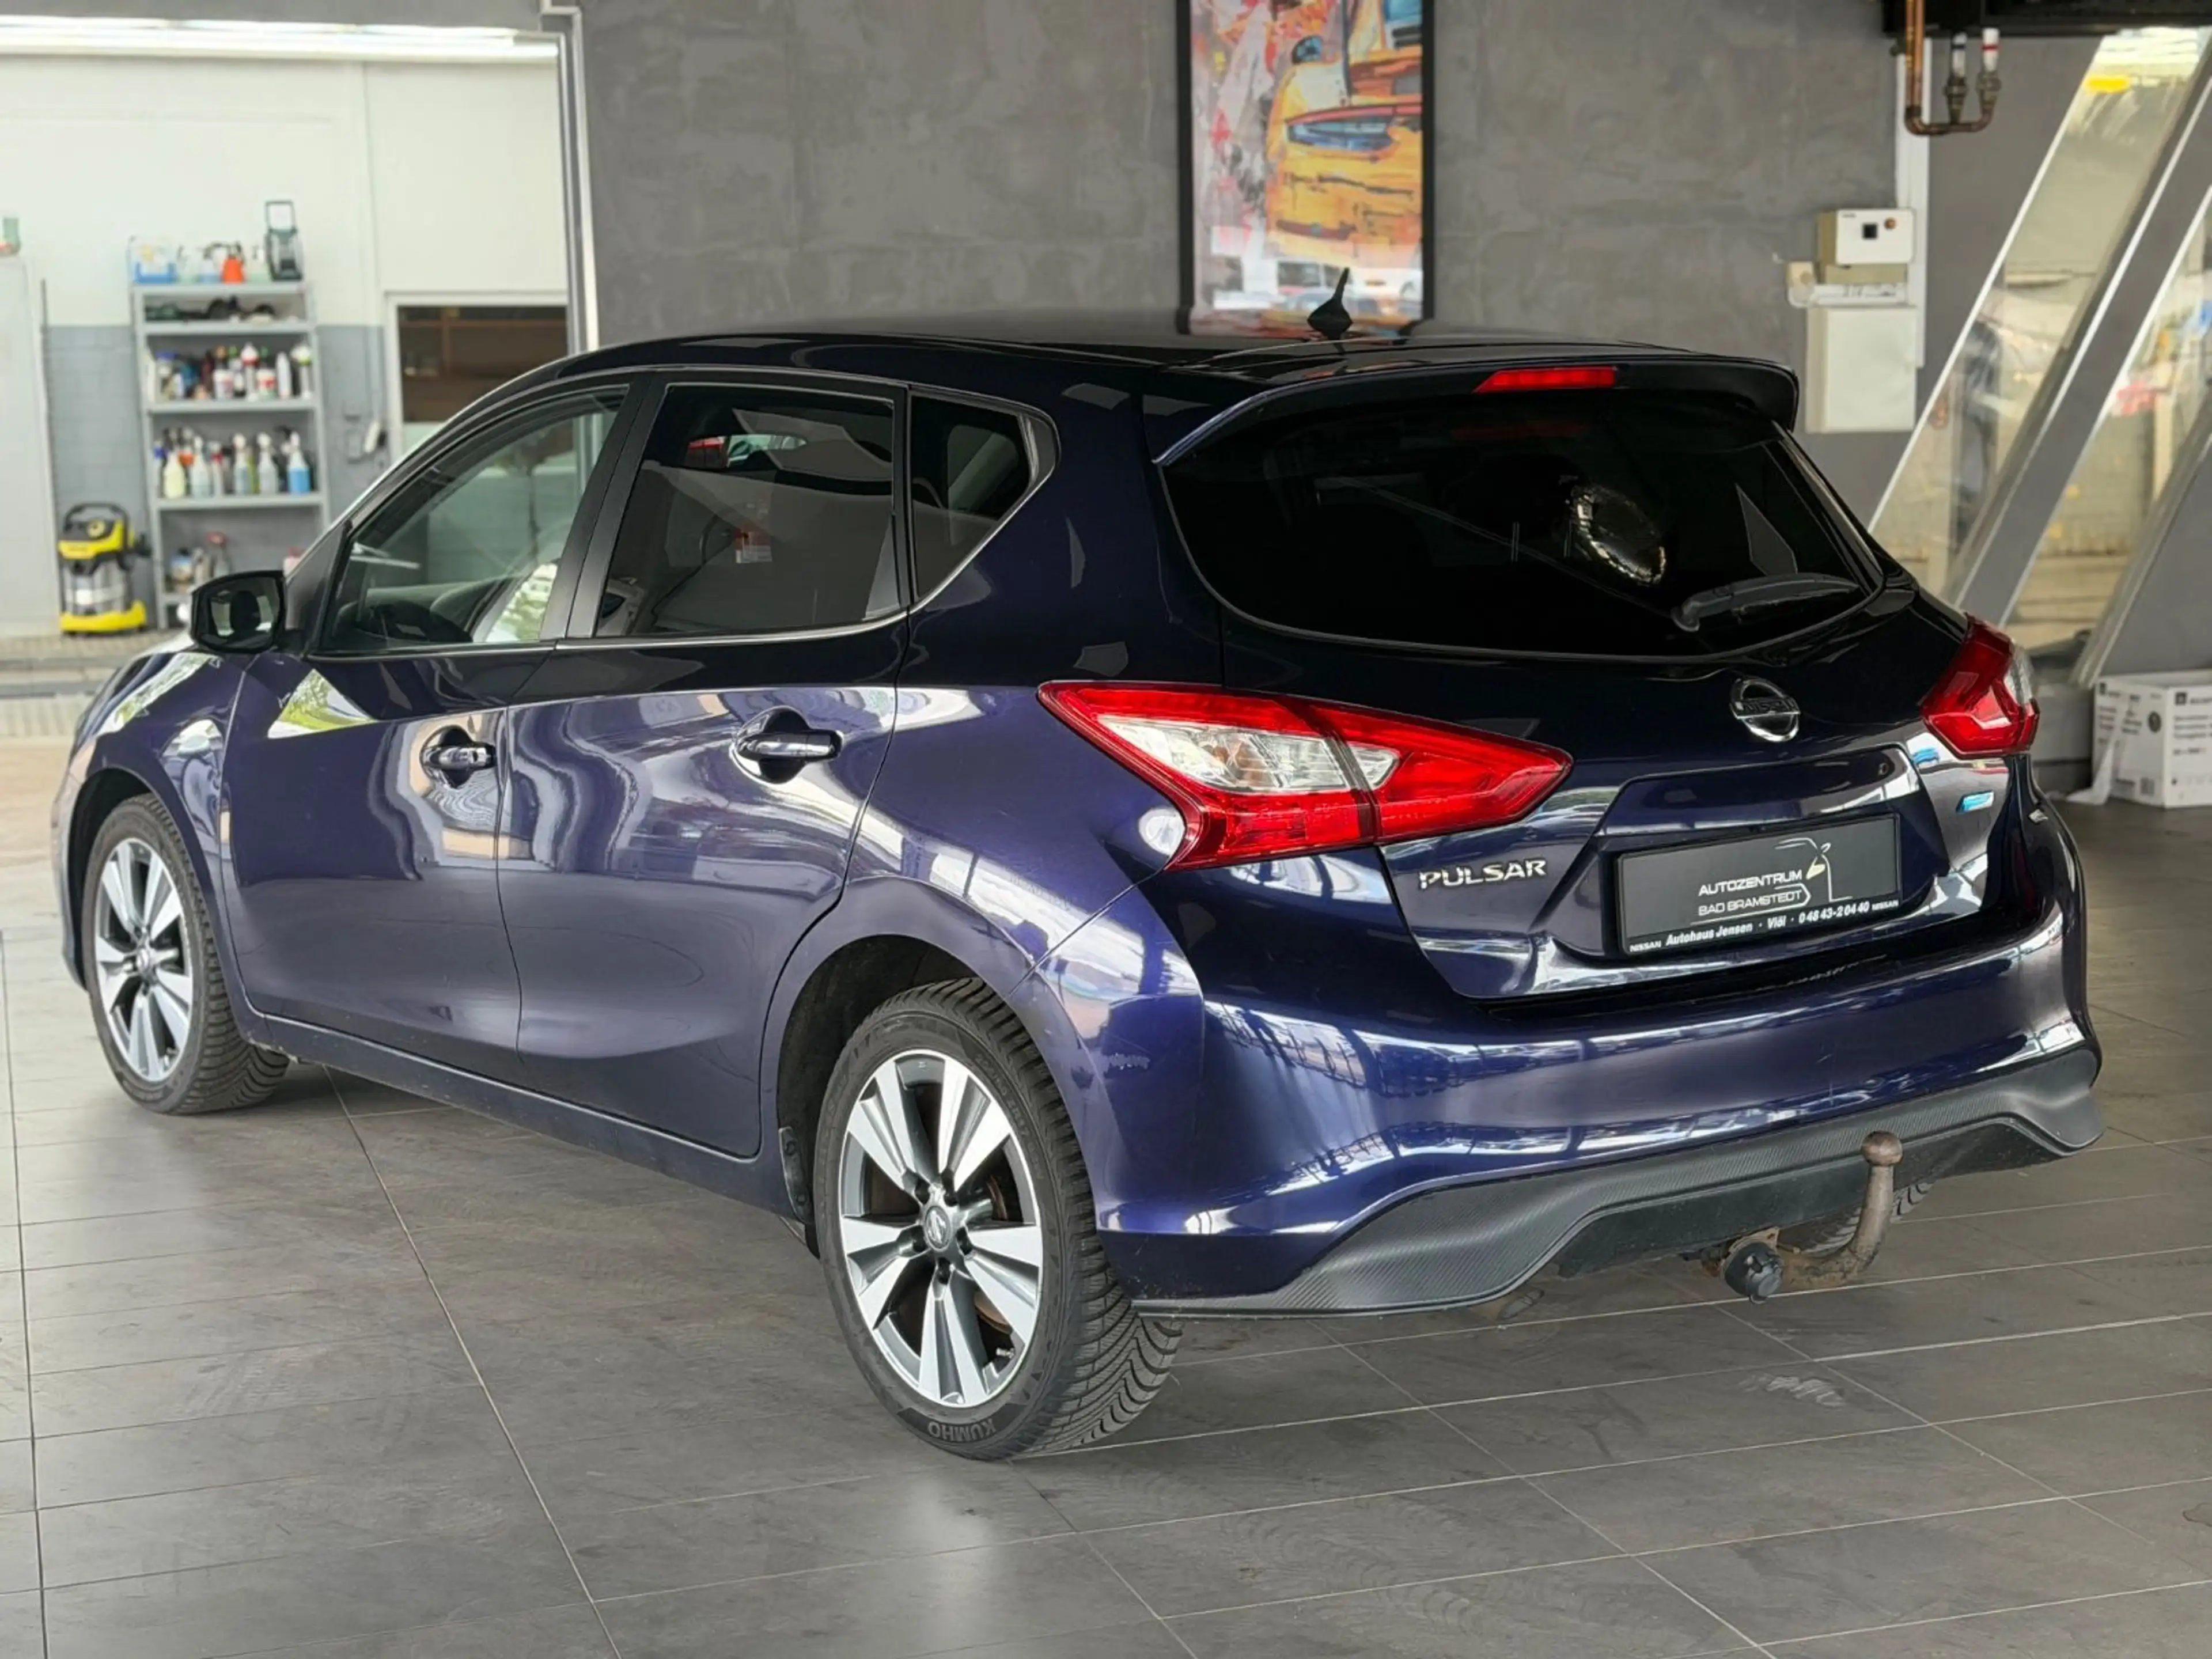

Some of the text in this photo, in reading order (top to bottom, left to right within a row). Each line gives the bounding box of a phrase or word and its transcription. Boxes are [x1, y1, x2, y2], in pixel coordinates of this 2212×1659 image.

[1419, 859, 1547, 889] PULSAR
[1698, 869, 1802, 896] AUTOZENTRUM
[1698, 889, 1802, 916] BAD BRAMSTEDT
[1630, 940, 1662, 952] NISSAN
[1666, 929, 1714, 946] Autohaus
[1715, 923, 1753, 938] Jensen
[928, 1418, 997, 1441] KUMHO
